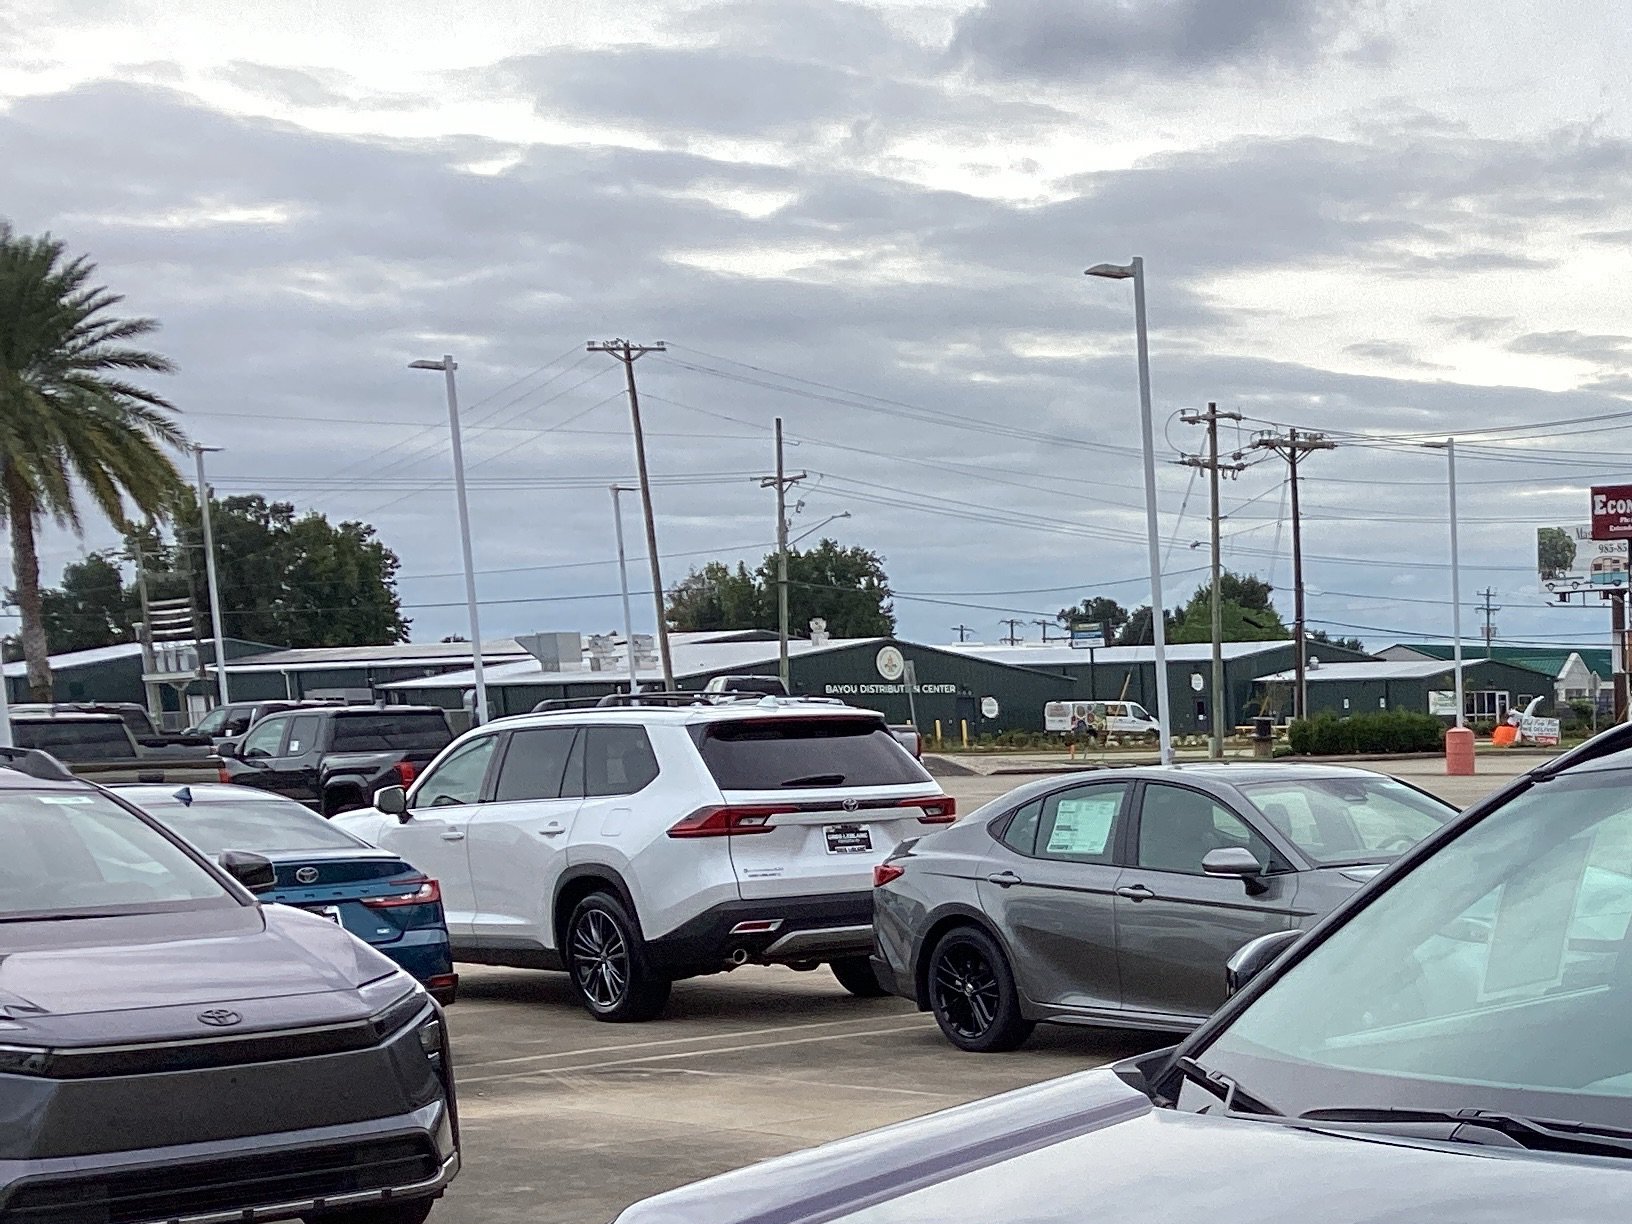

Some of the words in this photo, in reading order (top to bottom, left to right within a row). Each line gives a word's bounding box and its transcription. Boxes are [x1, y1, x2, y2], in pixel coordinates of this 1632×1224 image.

[825, 684, 857, 694] BAYOU
[860, 684, 920, 694] DISTRIBUTN
[922, 684, 957, 693] CENTER
